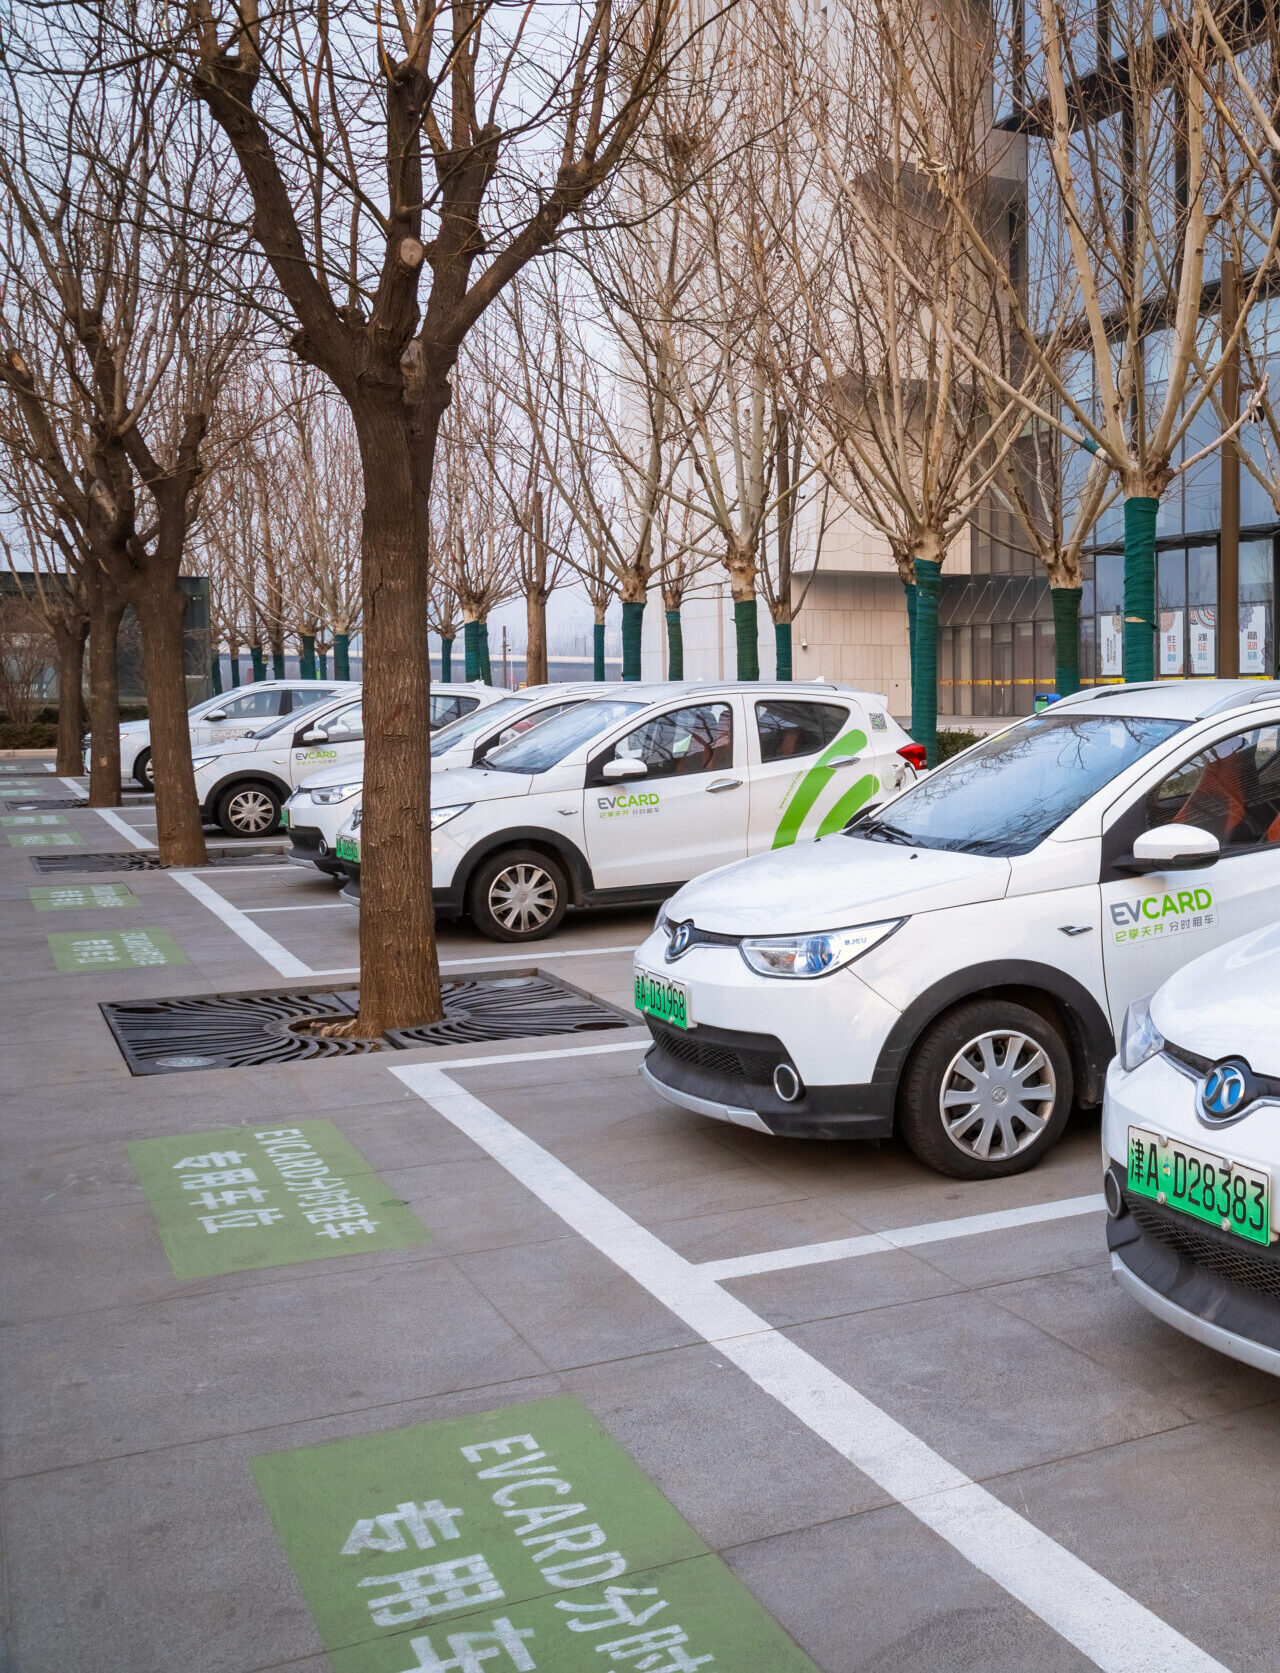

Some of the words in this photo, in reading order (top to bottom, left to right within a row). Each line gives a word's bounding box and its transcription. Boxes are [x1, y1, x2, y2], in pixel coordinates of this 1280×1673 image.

[295, 750, 337, 761] EVCARD
[597, 793, 660, 810] EVCARD
[1109, 888, 1213, 926] EVCARD
[1169, 914, 1214, 931] 分时租车
[172, 1150, 286, 1234] 专用车位
